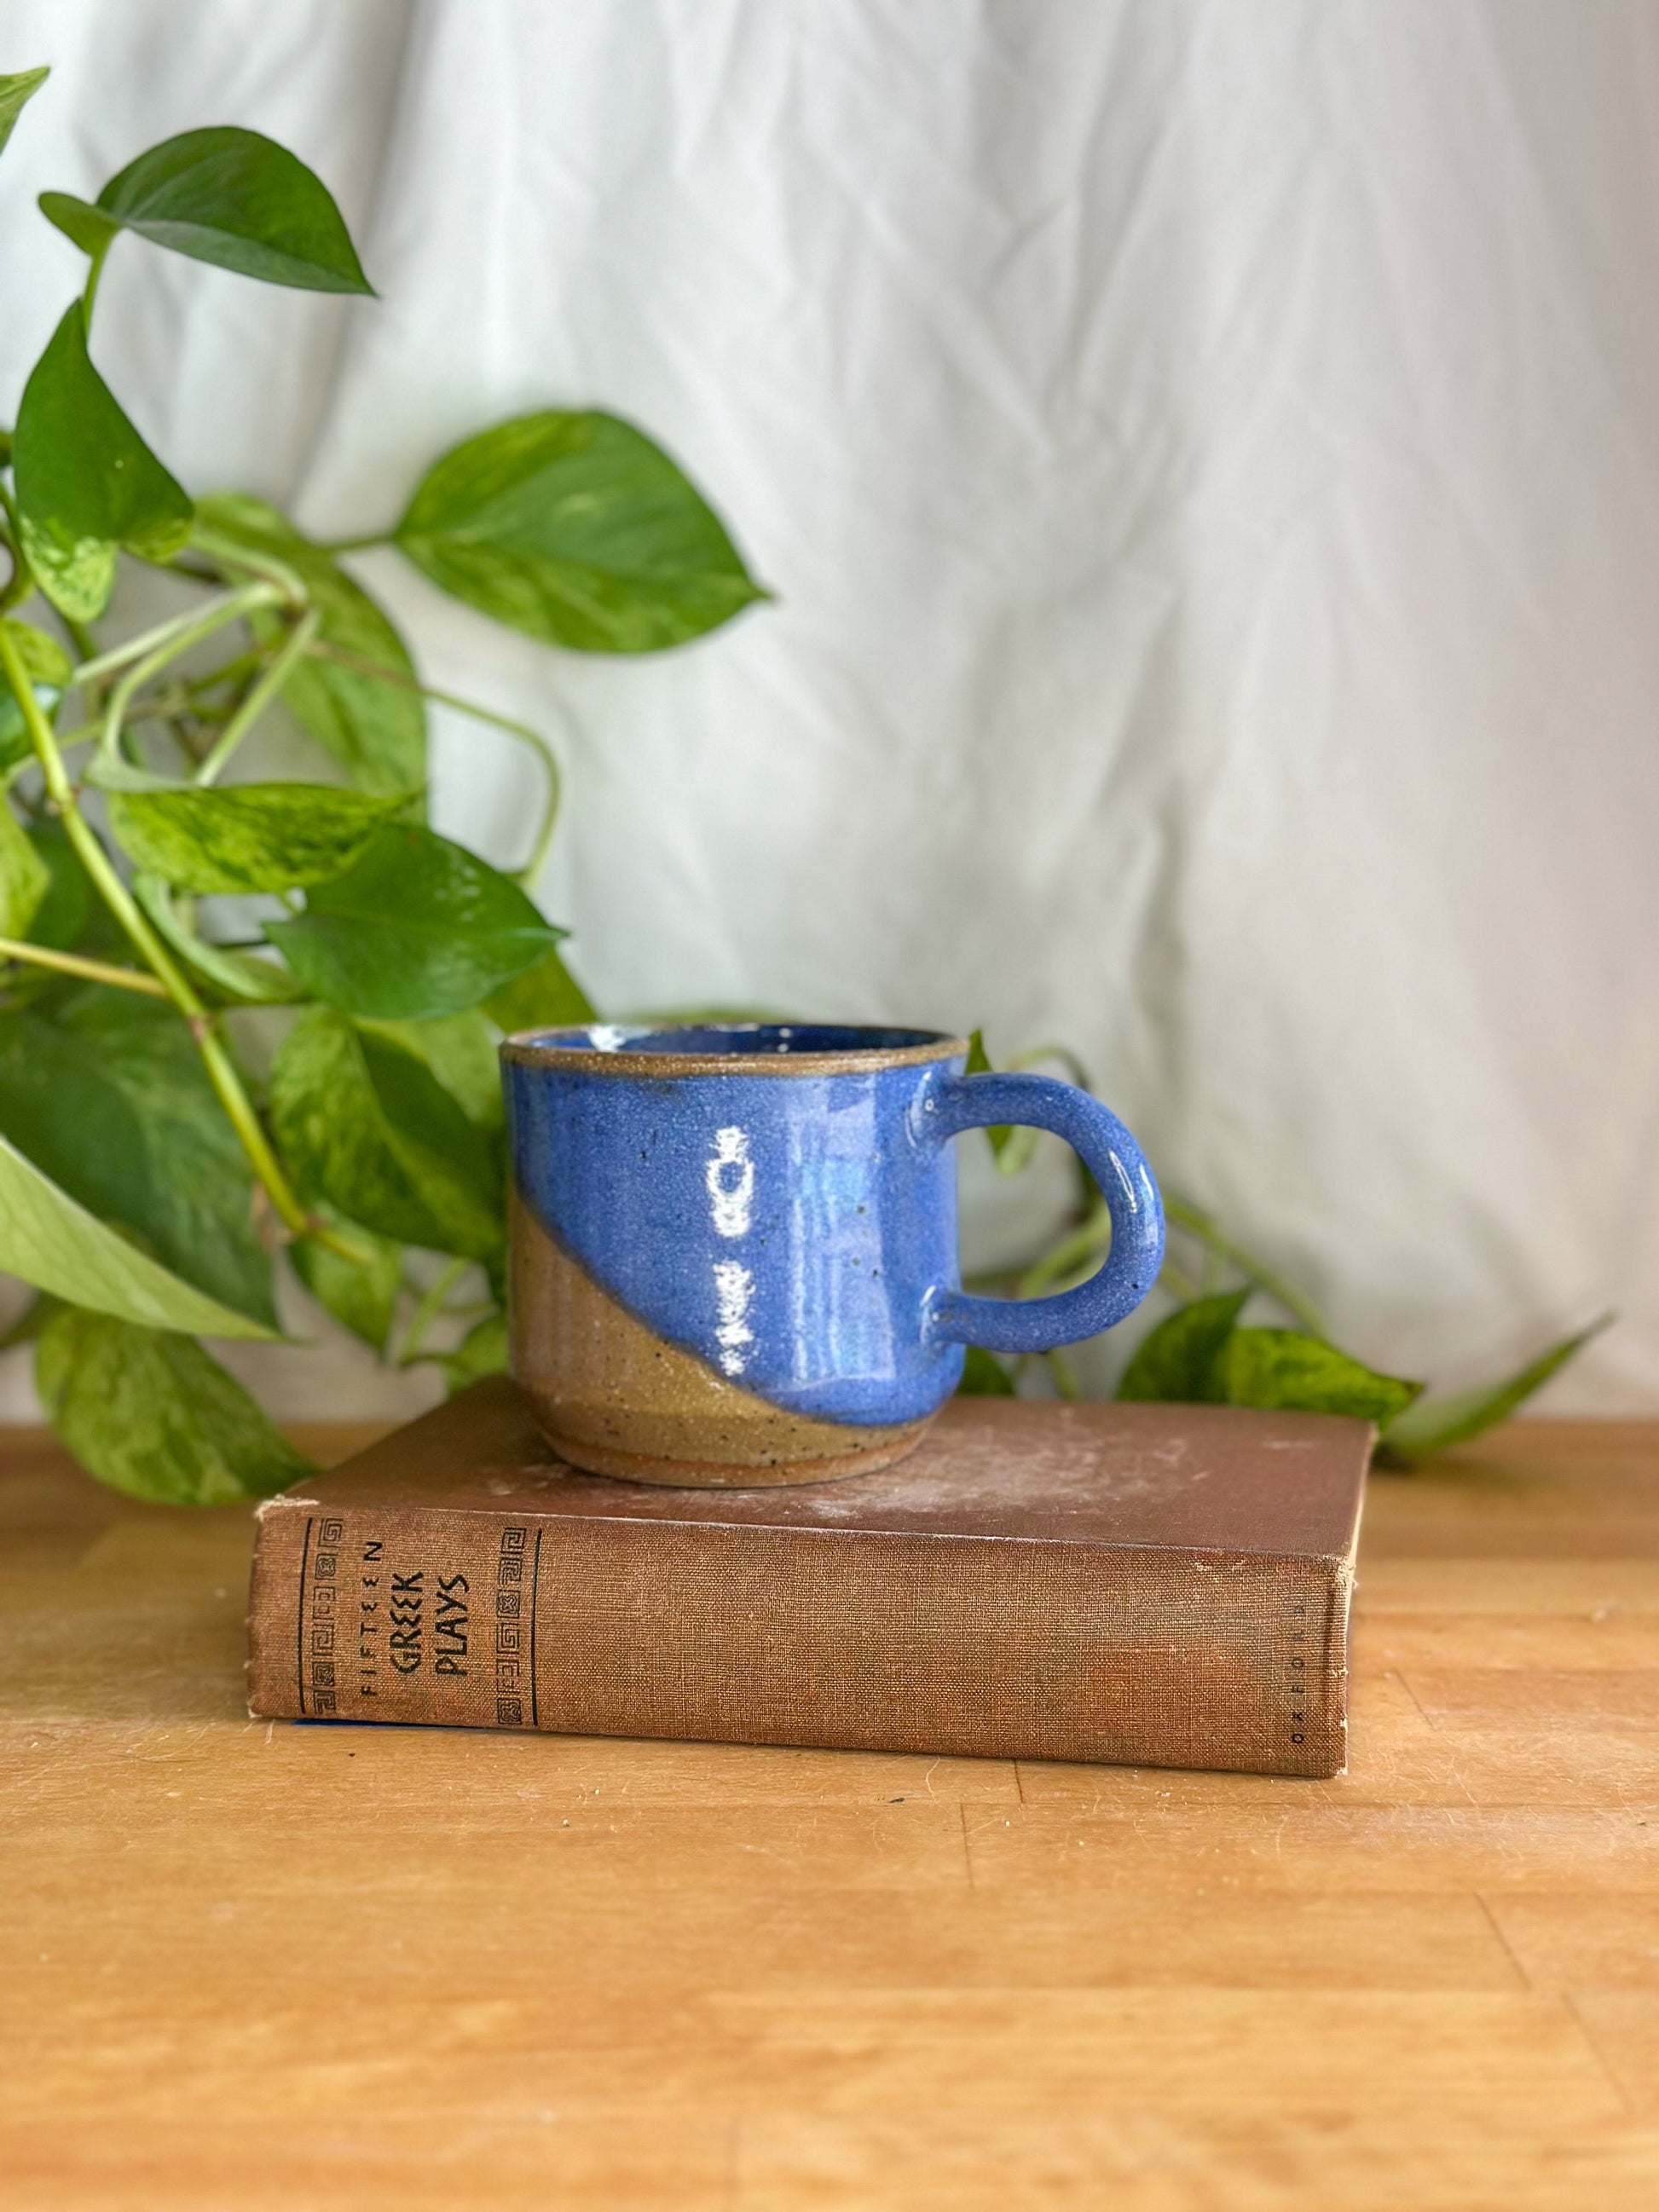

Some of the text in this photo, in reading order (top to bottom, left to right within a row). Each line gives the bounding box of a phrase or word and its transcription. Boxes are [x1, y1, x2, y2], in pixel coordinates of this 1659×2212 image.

[360, 1541, 384, 1696] FIFTEEN
[389, 1571, 424, 1673] GREEK
[435, 1574, 470, 1676] PLAYS
